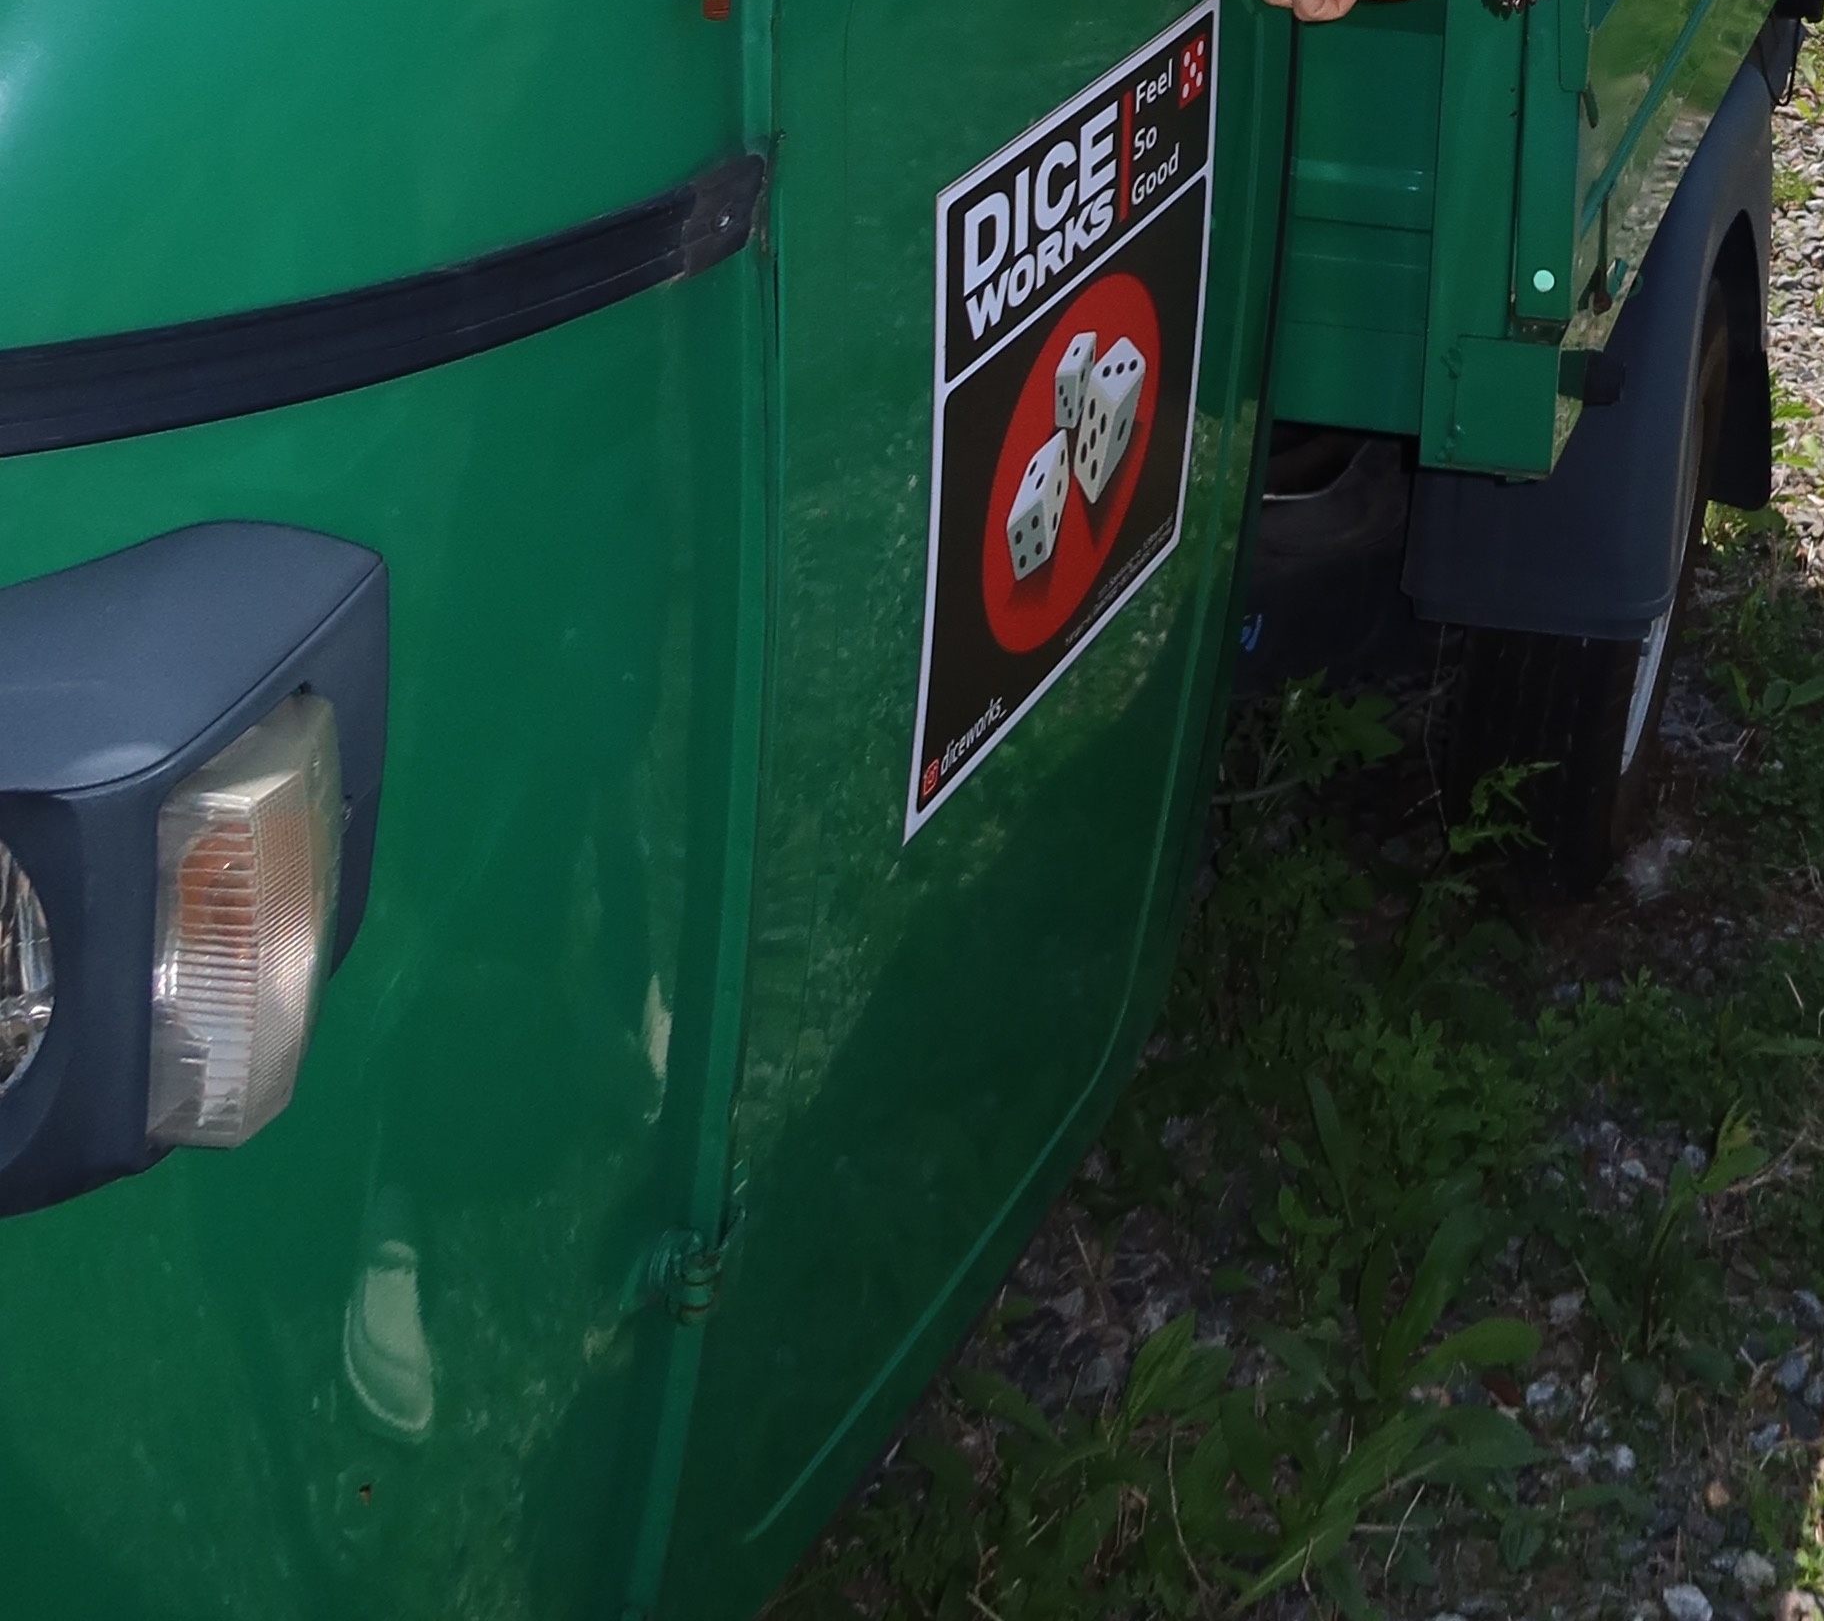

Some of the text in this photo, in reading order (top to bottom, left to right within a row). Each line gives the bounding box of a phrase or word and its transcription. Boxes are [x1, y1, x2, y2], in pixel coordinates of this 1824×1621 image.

[1135, 58, 1174, 113] Feel
[1131, 142, 1180, 207] Good
[1133, 125, 1158, 162] So
[963, 100, 1119, 297] DICE
[965, 188, 1116, 341] WORKS
